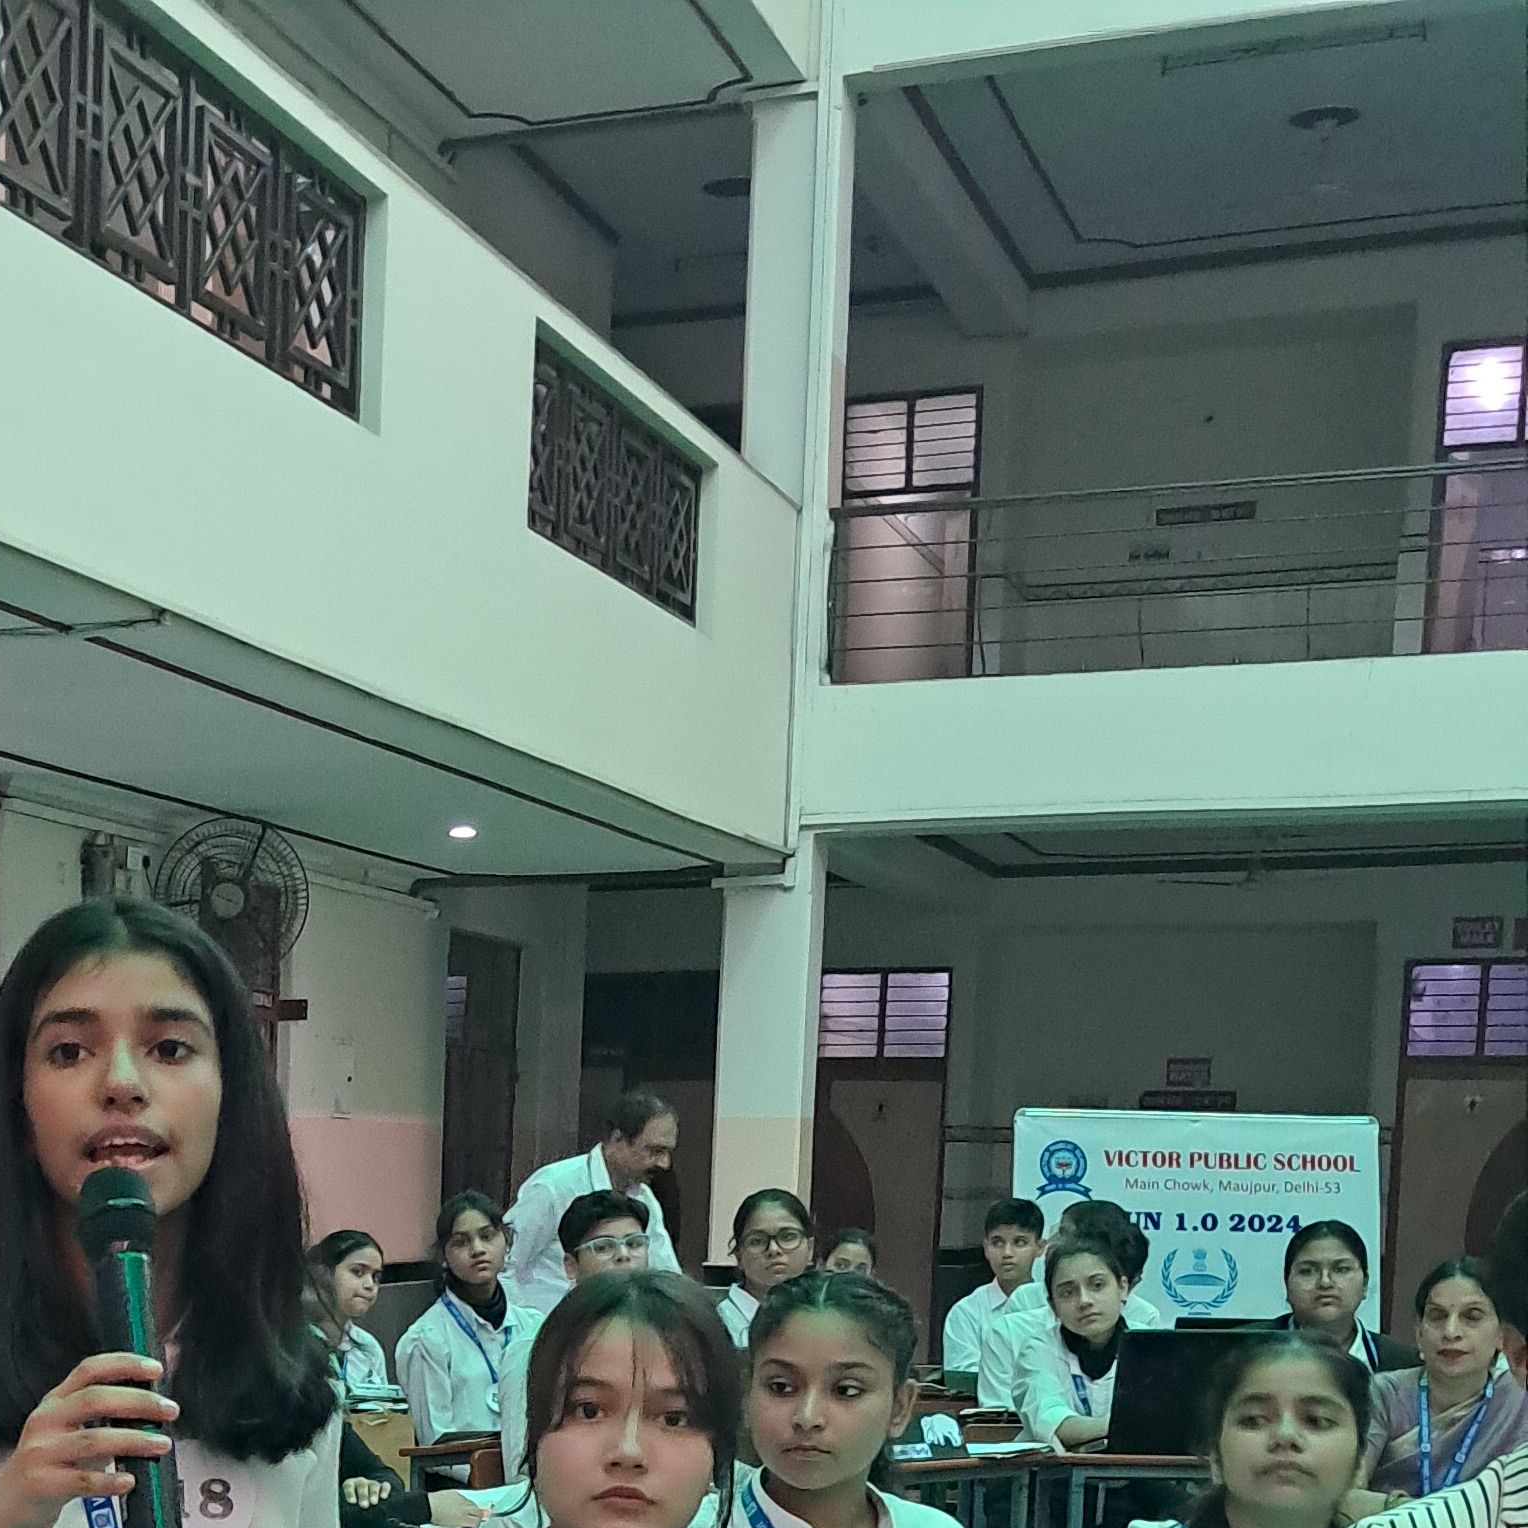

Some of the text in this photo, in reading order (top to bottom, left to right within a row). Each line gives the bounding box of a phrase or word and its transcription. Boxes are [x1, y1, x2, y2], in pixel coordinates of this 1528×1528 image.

[1103, 1150, 1361, 1173] VICTOR PUBLIC SCHOOL
[1125, 1177, 1342, 1195] Main Chowk, Maujpur, Delhi-53
[1175, 1212, 1219, 1232] 1.0
[1228, 1214, 1303, 1233] 2024
